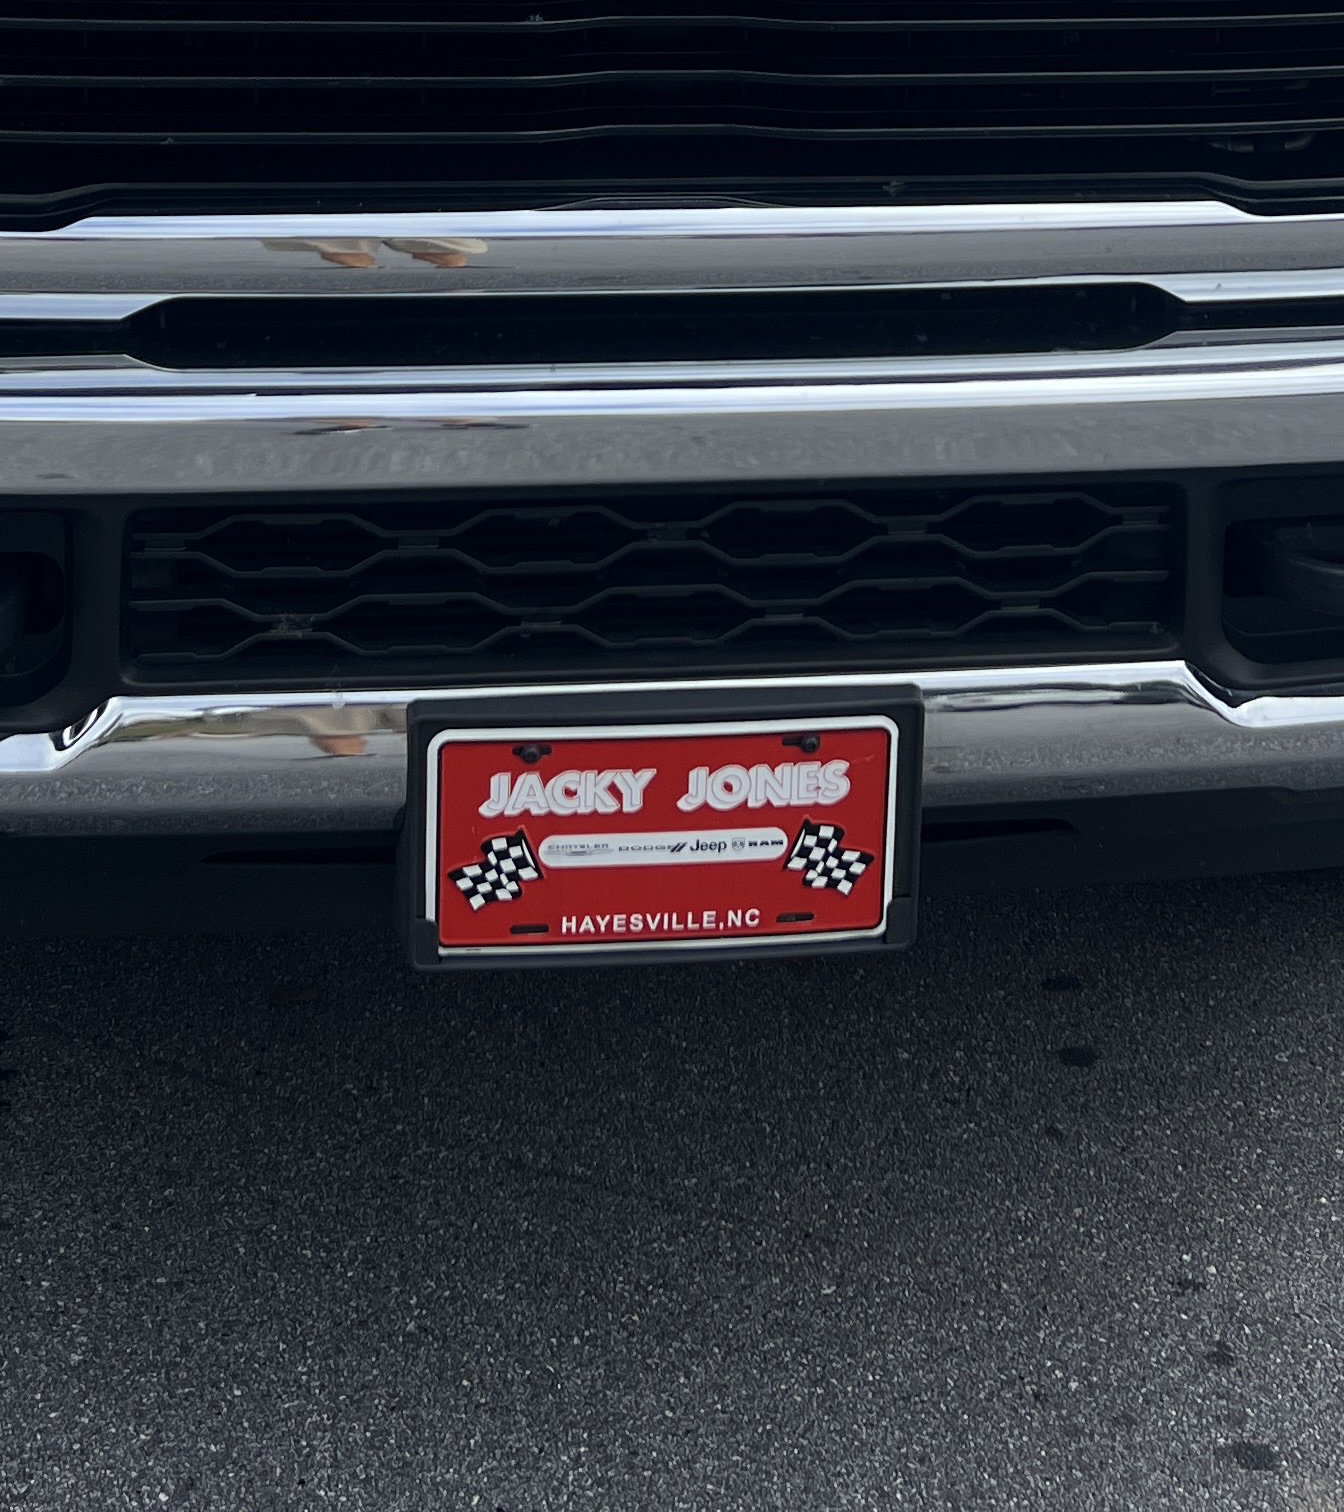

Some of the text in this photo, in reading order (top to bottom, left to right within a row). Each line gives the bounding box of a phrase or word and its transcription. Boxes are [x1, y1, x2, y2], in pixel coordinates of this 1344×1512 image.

[478, 759, 852, 818] JACKY JONES
[689, 839, 728, 854] Jeep
[748, 839, 784, 847] RAM
[561, 908, 761, 935] HAYESVILLE,NC
